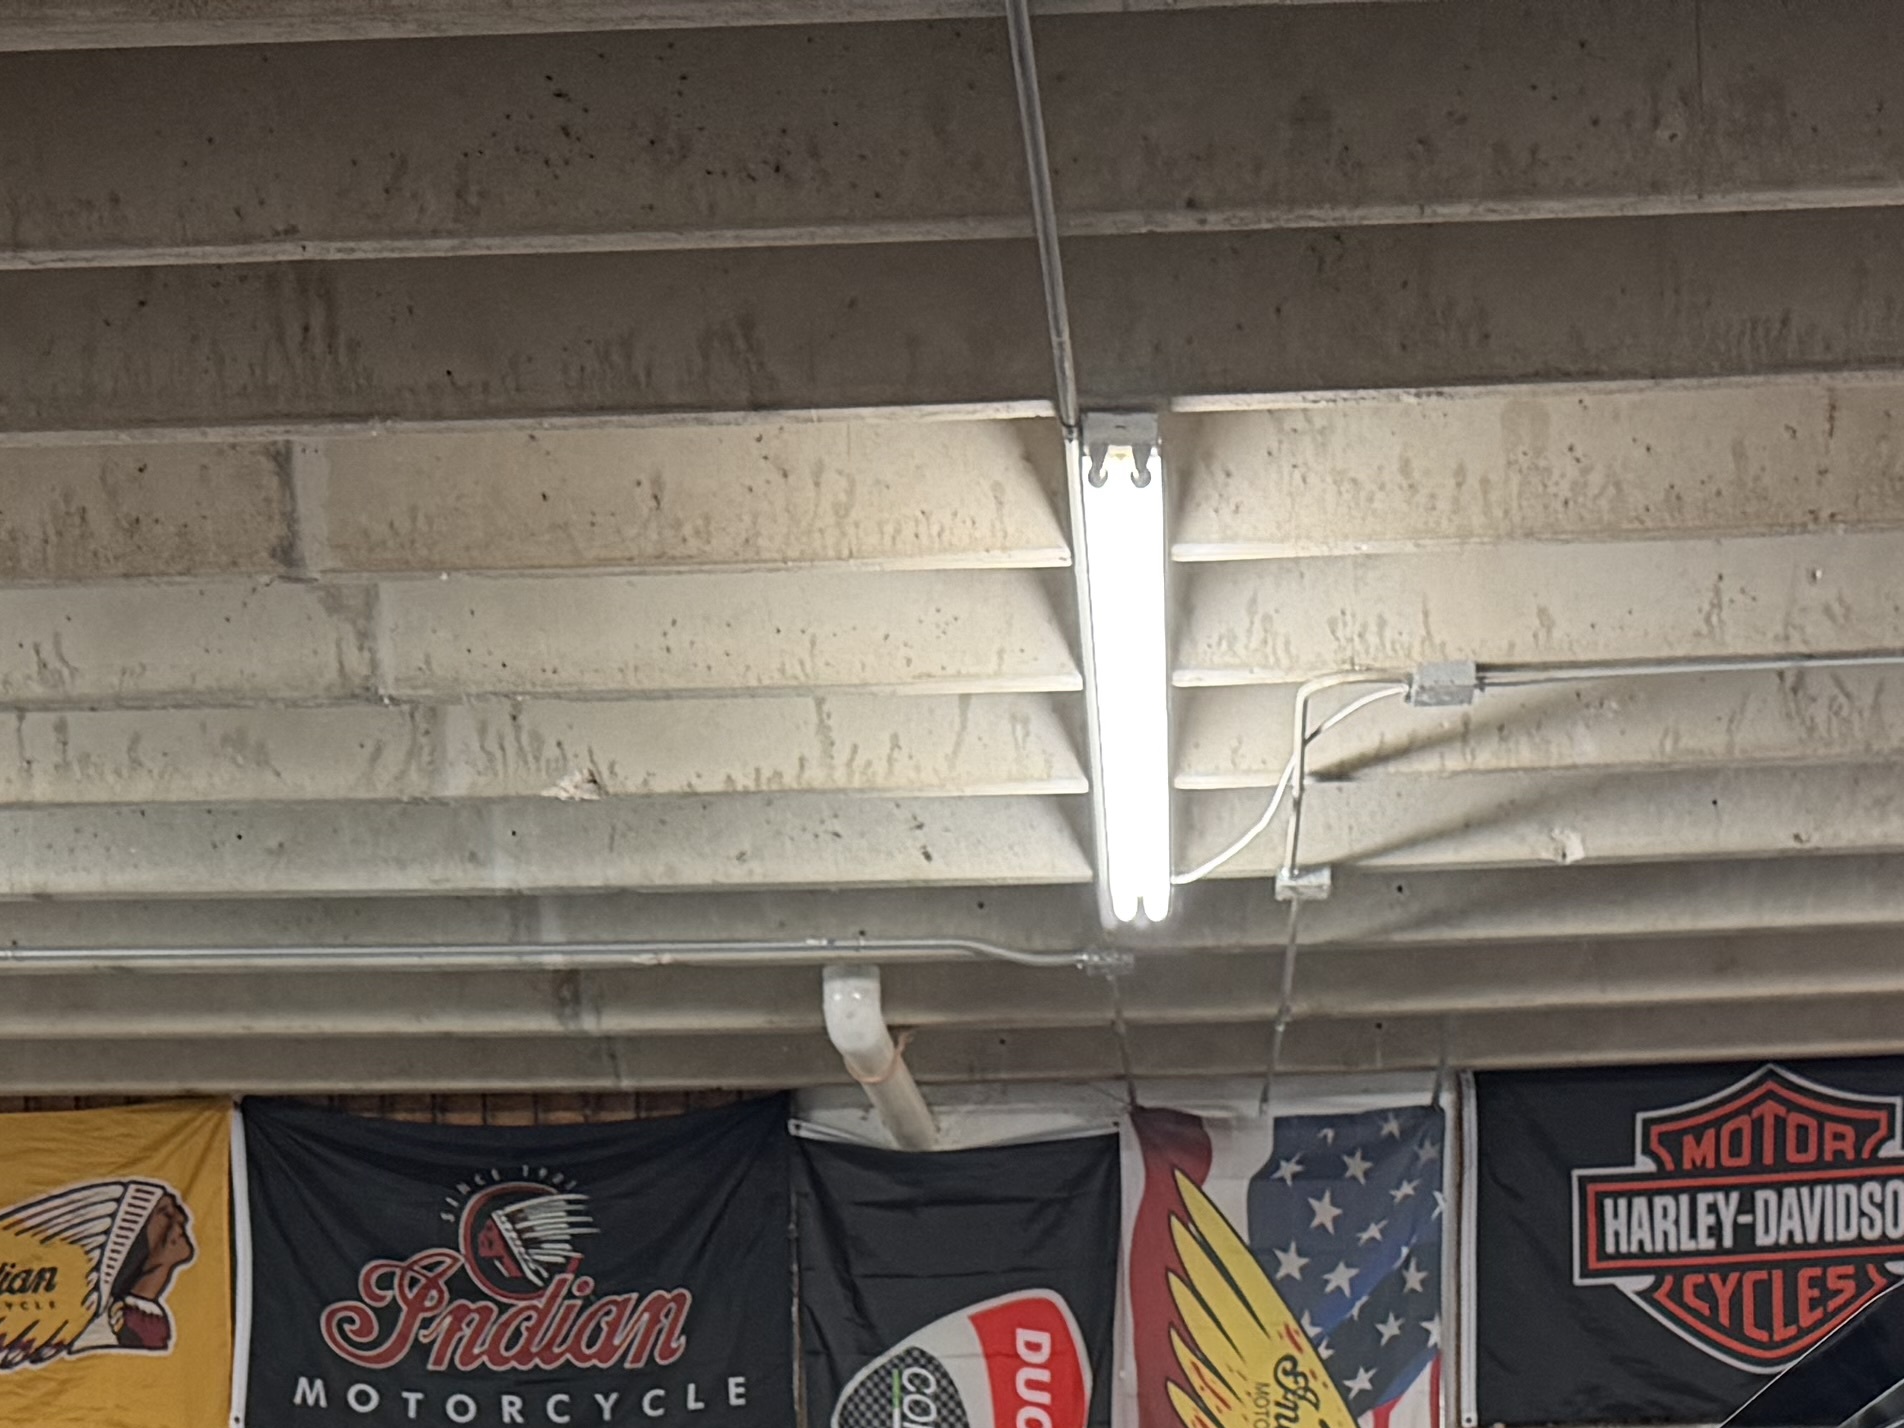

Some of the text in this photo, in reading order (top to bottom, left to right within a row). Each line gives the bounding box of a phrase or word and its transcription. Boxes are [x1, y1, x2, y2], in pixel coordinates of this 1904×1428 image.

[1682, 1099, 1857, 1169] MOTOR
[320, 1248, 693, 1372] Indian
[1683, 1264, 1856, 1343] CYCLES
[293, 1376, 747, 1424] MOTORCYCLE
